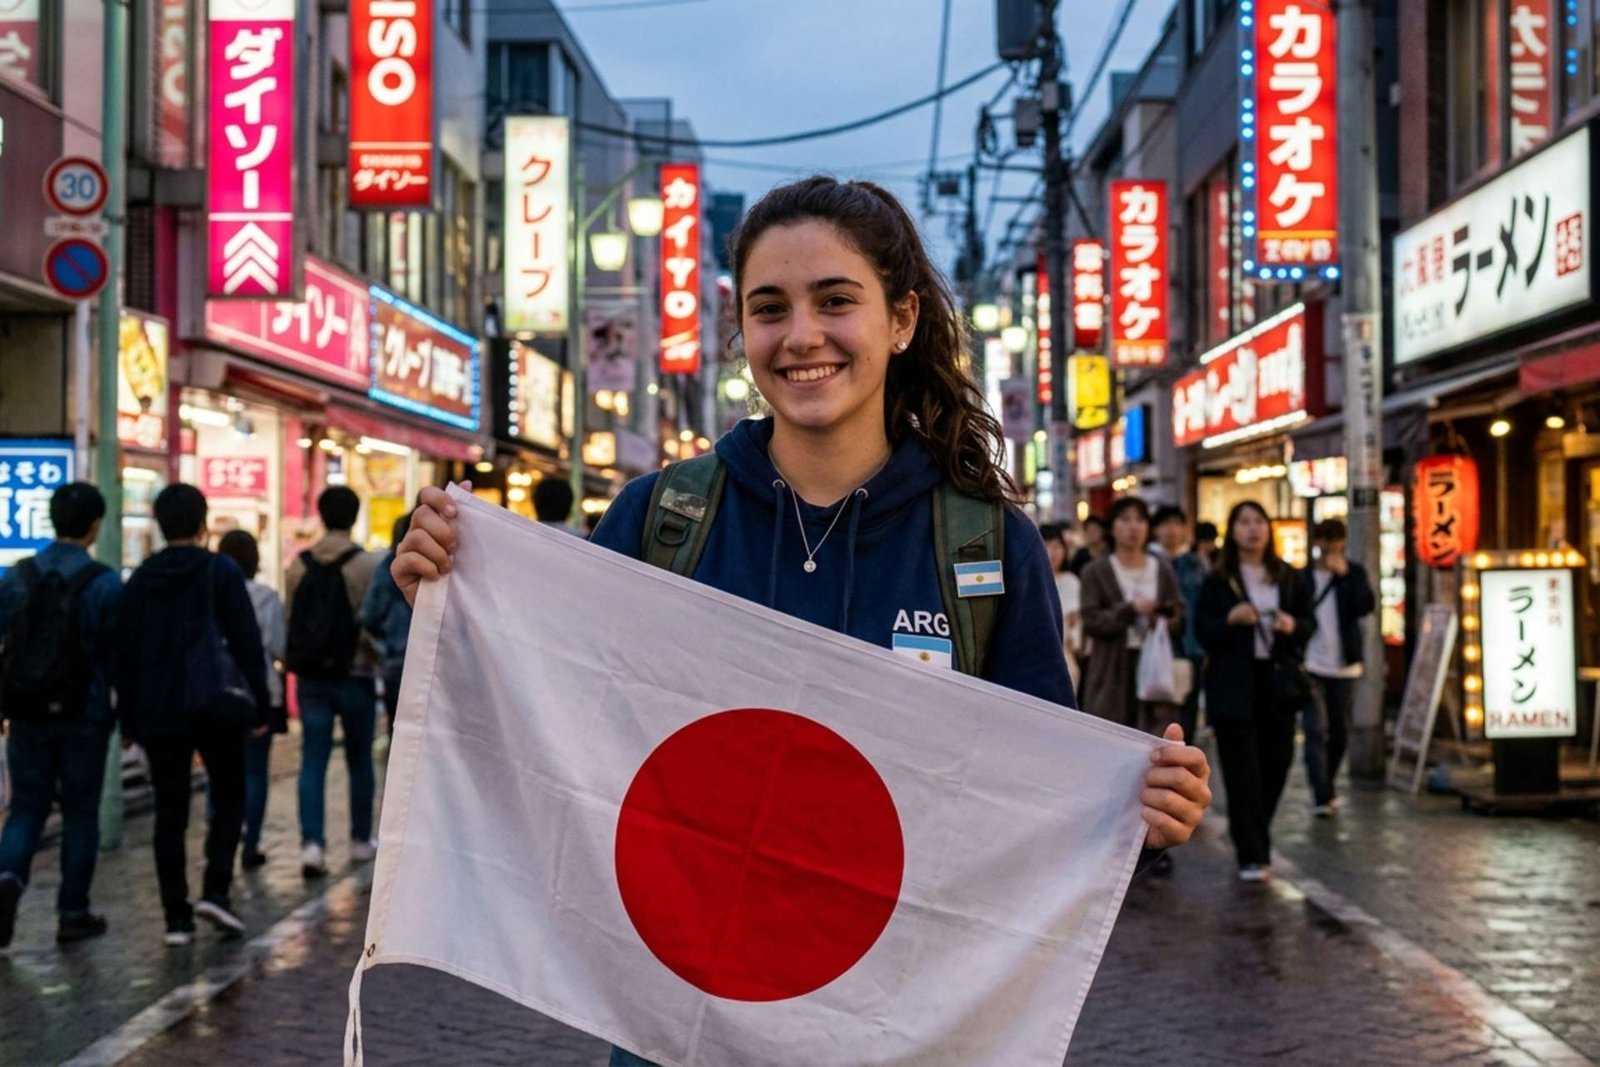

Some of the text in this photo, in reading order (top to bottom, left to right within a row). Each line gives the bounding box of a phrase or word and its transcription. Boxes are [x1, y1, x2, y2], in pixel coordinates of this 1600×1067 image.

[224, 26, 283, 209] ダイソー
[1268, 5, 1325, 228] カラオケ
[60, 173, 97, 200] 30
[1119, 185, 1161, 340] カラオケ
[1453, 192, 1550, 318] ラーメン
[1429, 470, 1456, 561] ラーメン
[893, 608, 951, 637] ARG
[1509, 586, 1538, 705] ラーメン
